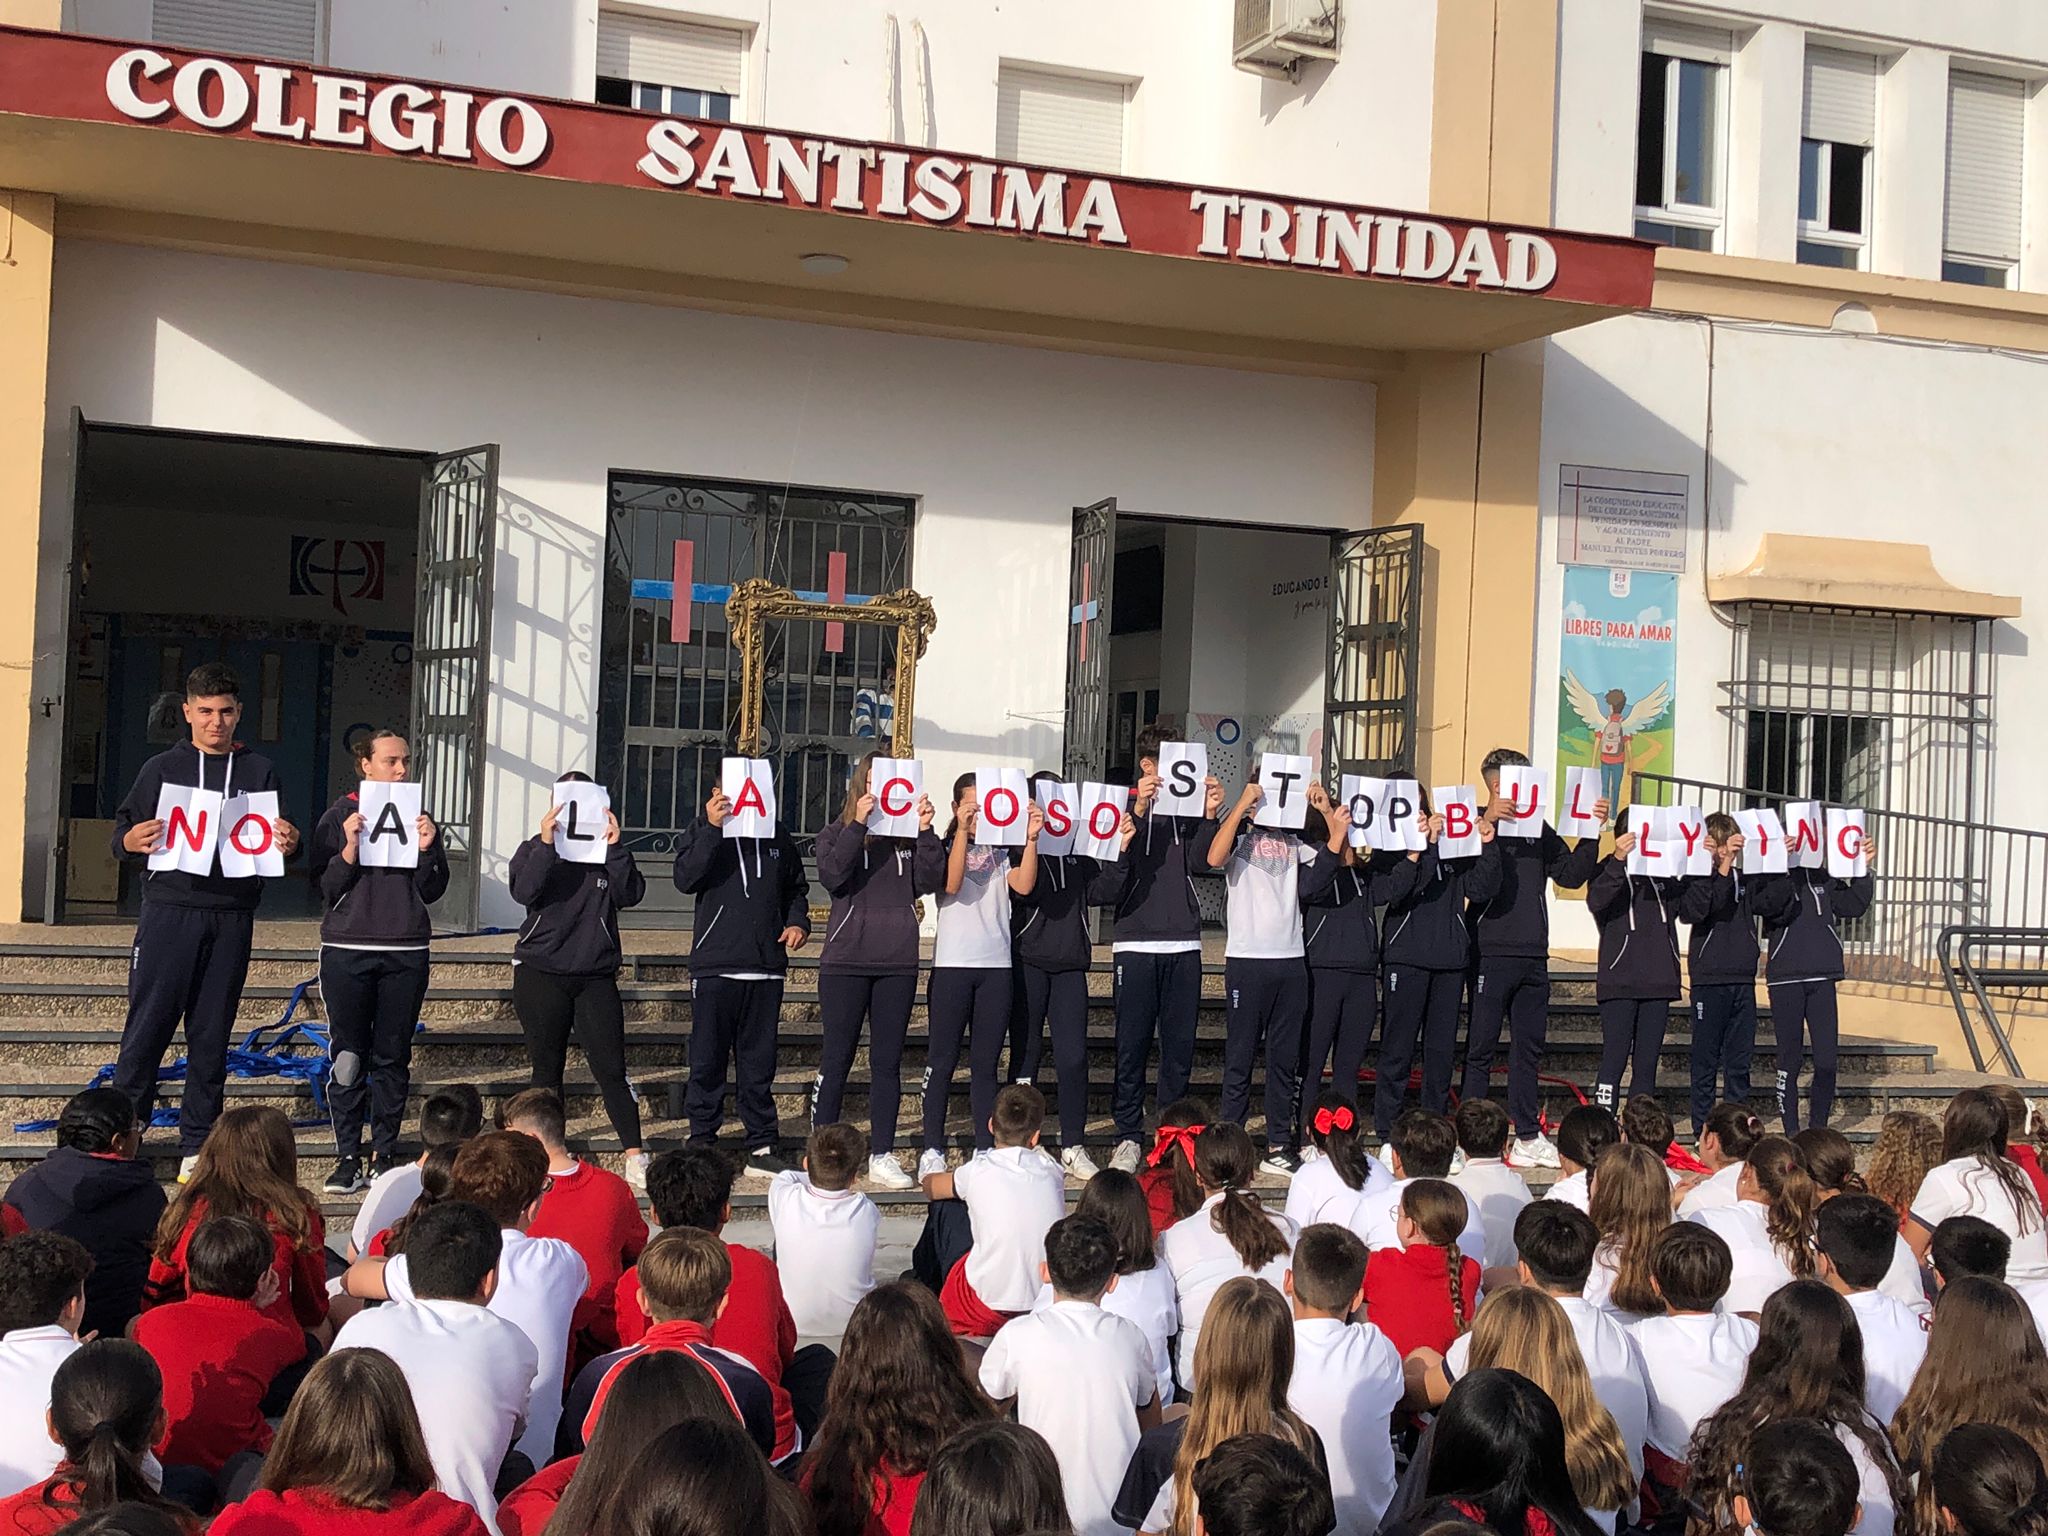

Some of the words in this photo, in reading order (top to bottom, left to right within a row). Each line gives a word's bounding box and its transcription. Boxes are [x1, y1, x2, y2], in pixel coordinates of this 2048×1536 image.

[105, 49, 549, 167] COLEGIO
[636, 120, 1128, 243] SANTISIMA
[1190, 190, 1557, 291] TRINIDAD
[1273, 578, 1320, 596] EDUCANDO
[1565, 618, 1602, 637] LIBRES
[1607, 622, 1635, 639] PARA
[1639, 624, 1672, 641] AMAR
